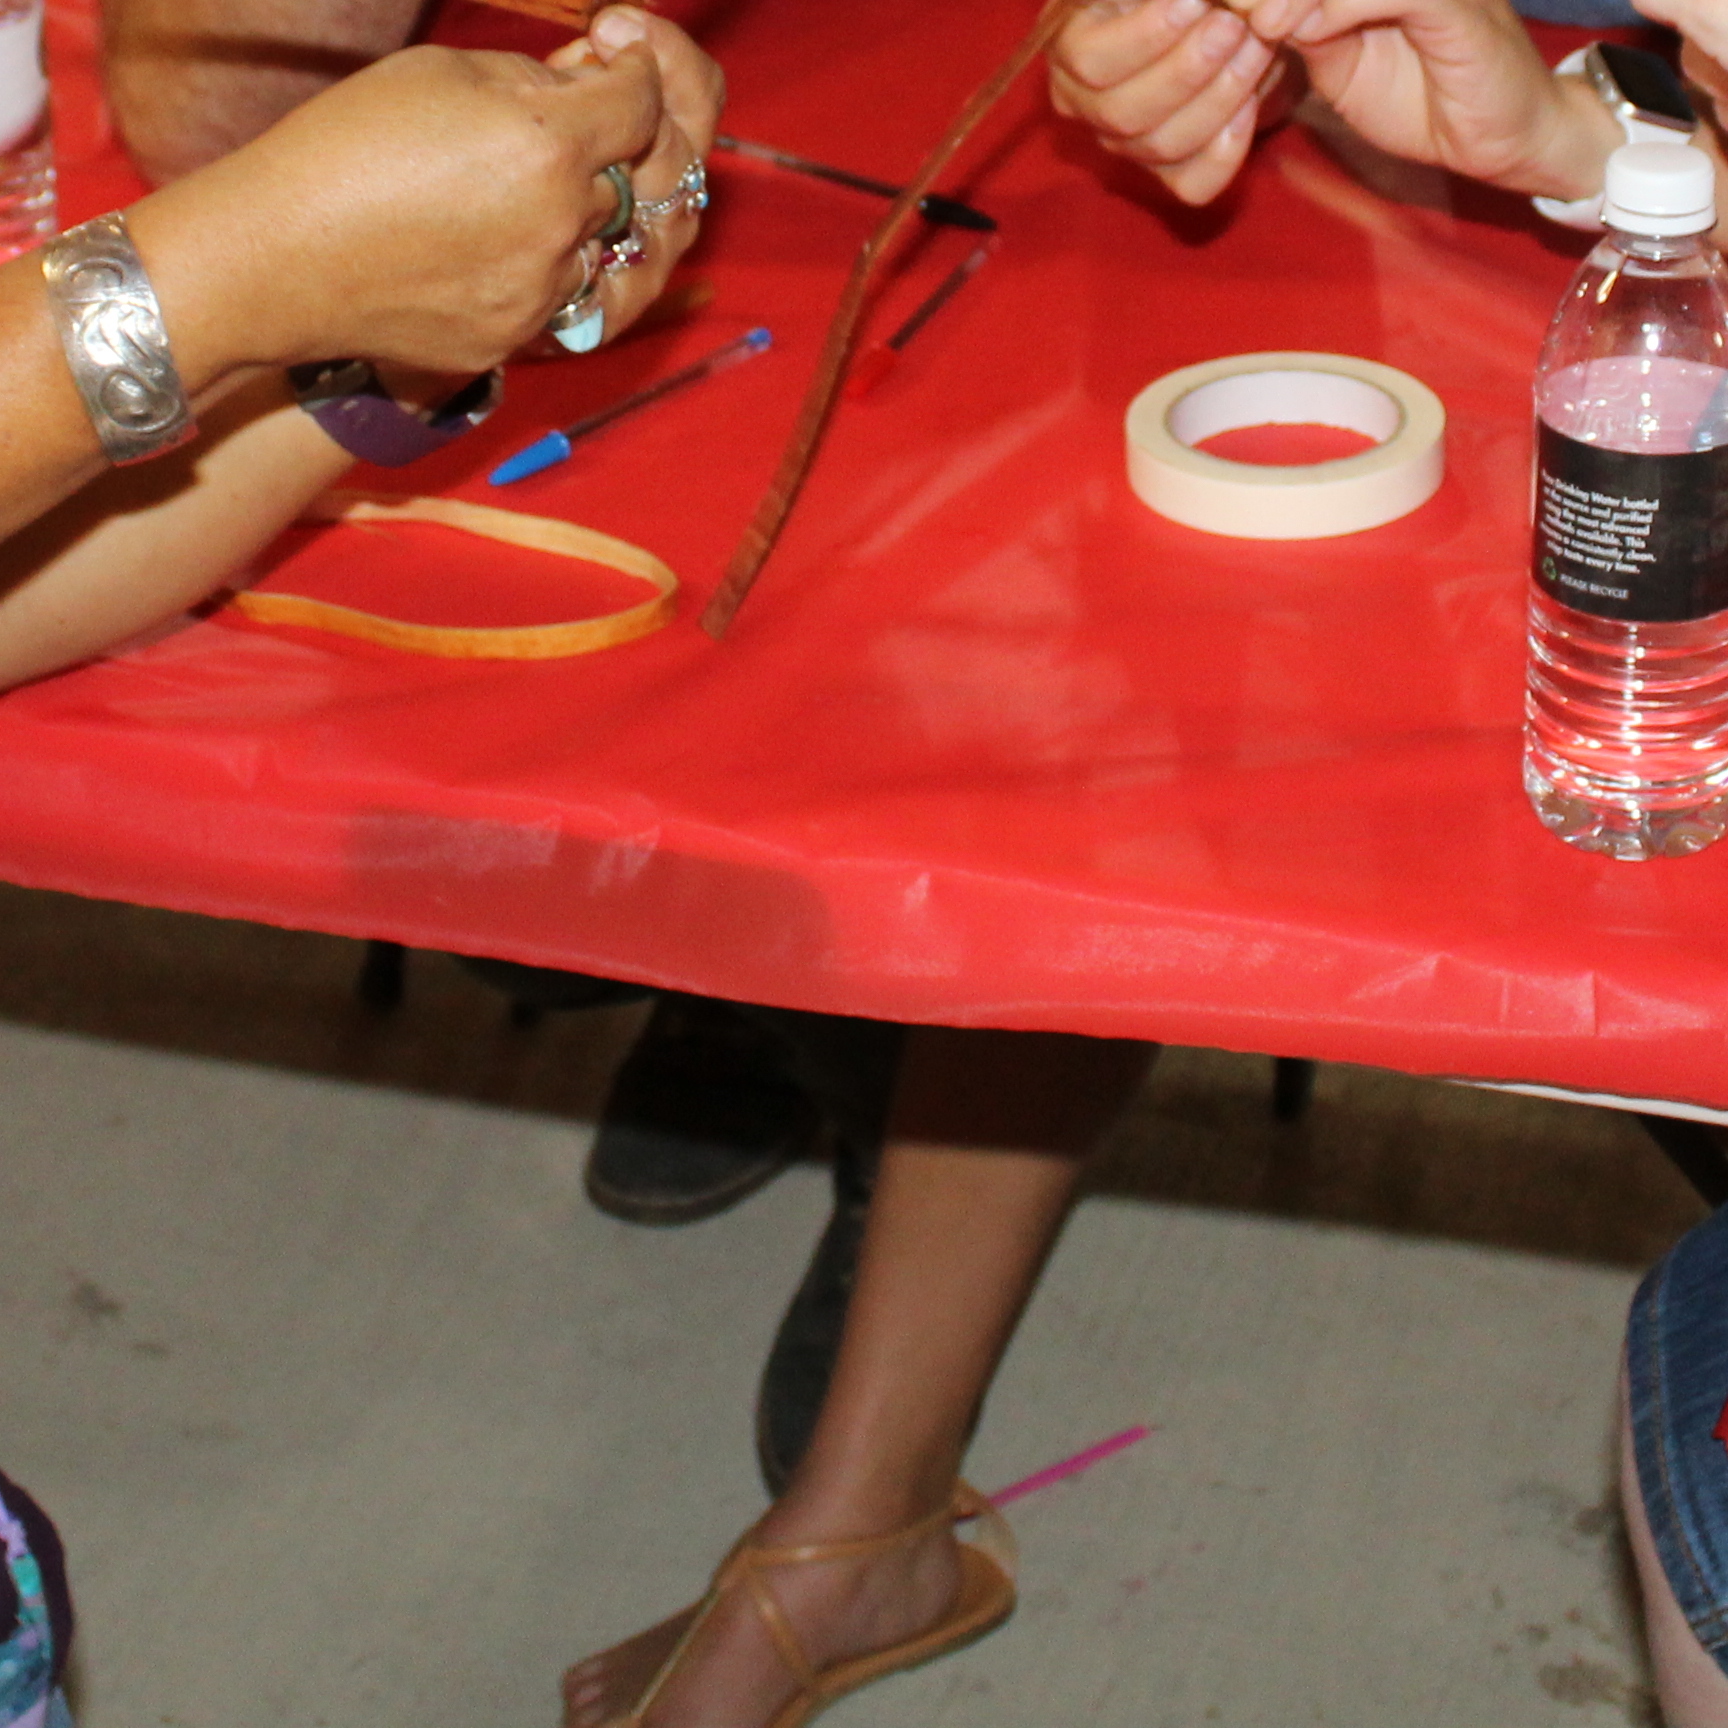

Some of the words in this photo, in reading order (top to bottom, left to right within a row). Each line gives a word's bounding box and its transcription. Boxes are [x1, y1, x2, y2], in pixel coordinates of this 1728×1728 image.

[1550, 488, 1562, 503] the
[1562, 497, 1590, 513] source
[1590, 507, 1611, 518] and
[1612, 511, 1654, 524] purified
[1554, 478, 1590, 503] Drinking
[1590, 491, 1621, 507] Water
[1622, 496, 1660, 511] bottled
[1562, 508, 1576, 521] the
[1576, 515, 1600, 528] most
[1600, 521, 1651, 536] advanced
[1571, 539, 1624, 560] consistently
[1625, 549, 1657, 563] clean,
[1575, 528, 1623, 546] available.
[1624, 535, 1647, 549] This
[1563, 547, 1584, 563] taste
[1585, 556, 1613, 572] every
[1614, 561, 1641, 574] time.
[1559, 573, 1588, 590] PLEASE
[1589, 582, 1630, 600] RECYCLE
